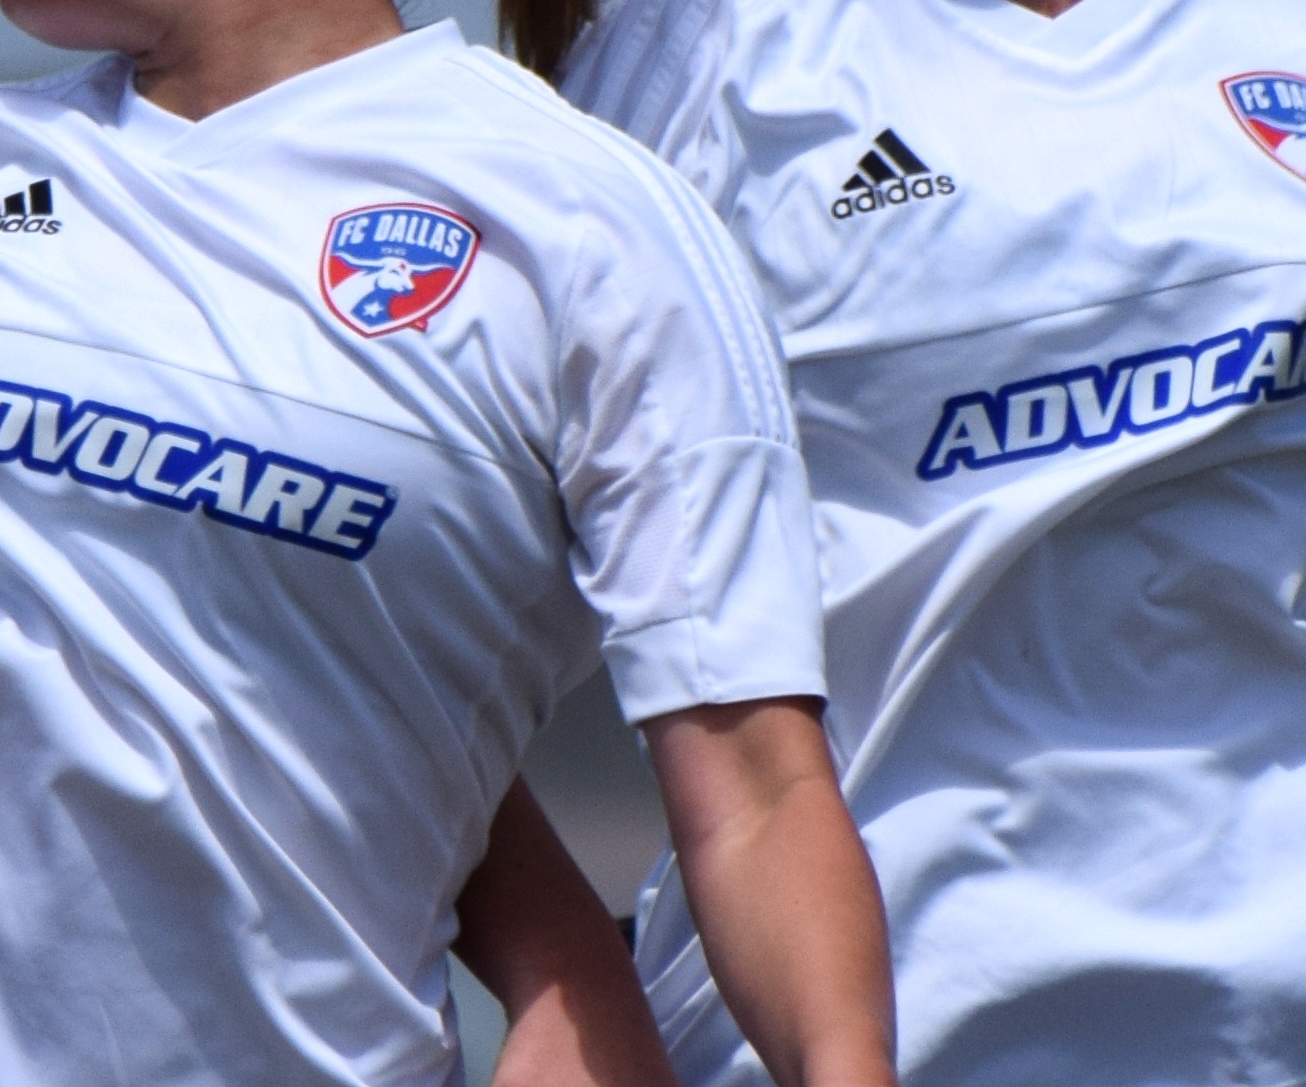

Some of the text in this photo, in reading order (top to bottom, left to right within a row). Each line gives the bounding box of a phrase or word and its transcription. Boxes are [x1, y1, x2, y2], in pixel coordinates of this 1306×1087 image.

[1239, 82, 1271, 111] FC
[831, 175, 955, 219] adidas
[337, 214, 463, 258] FC DALLAS
